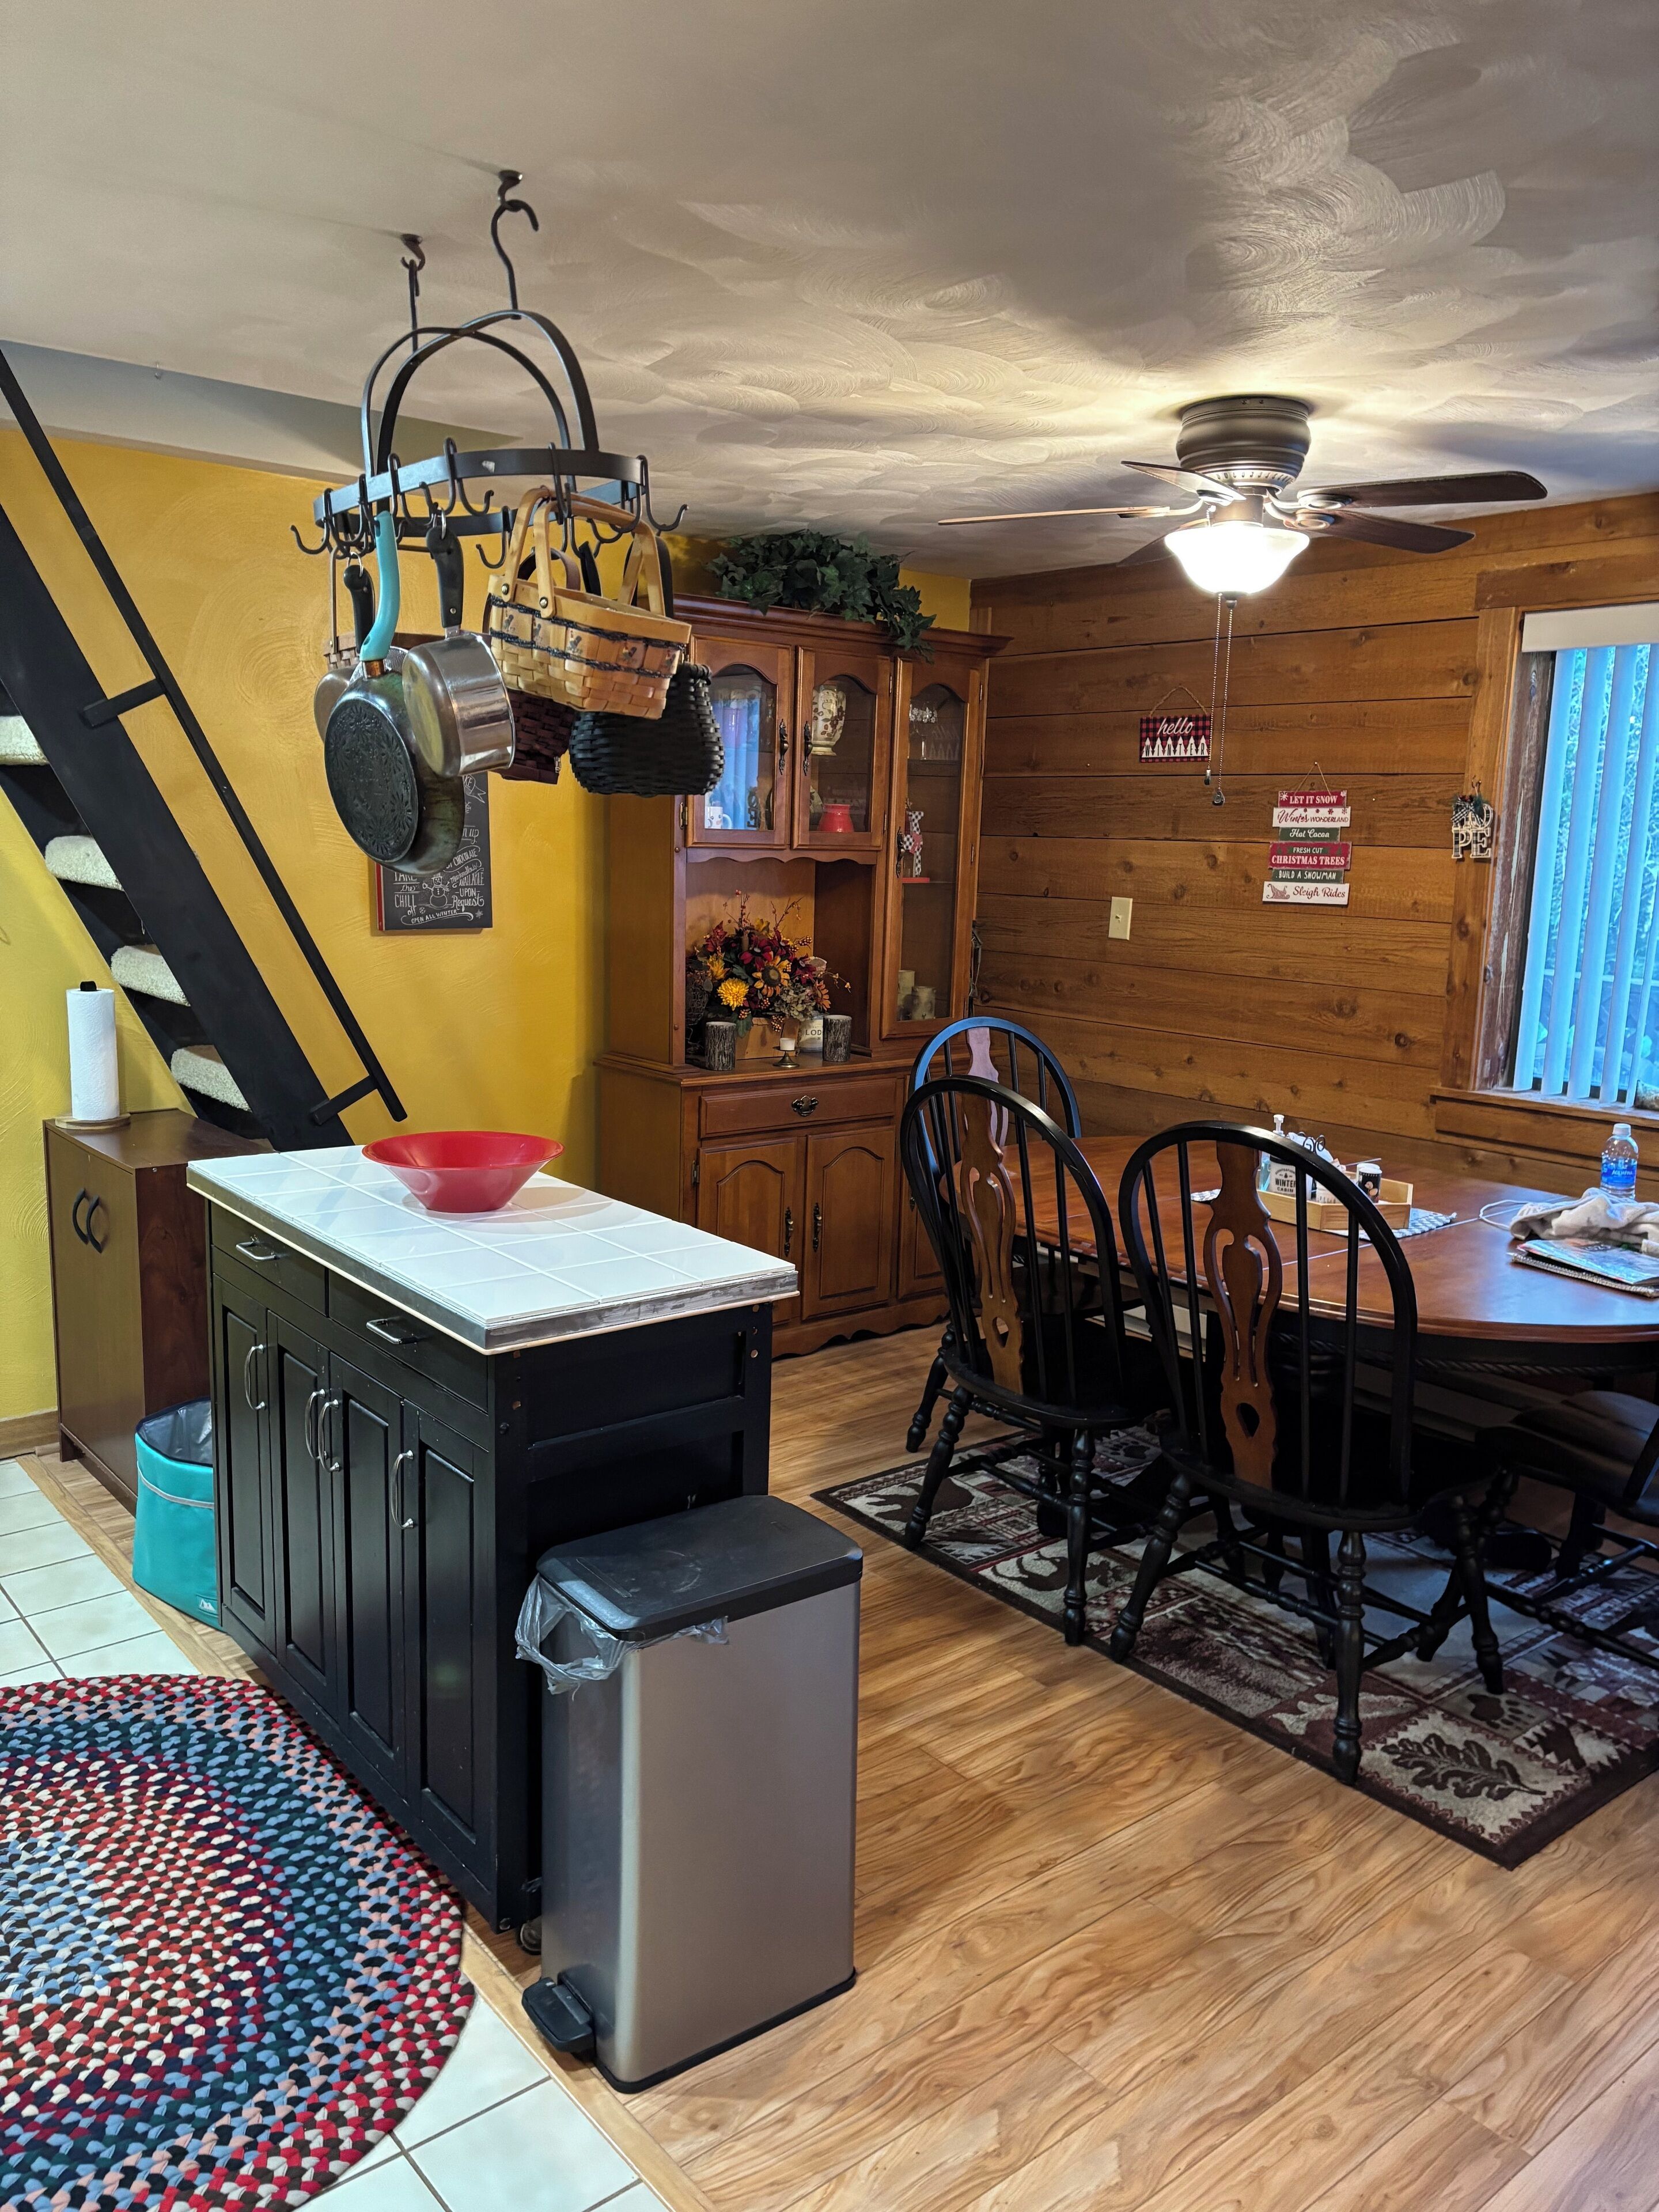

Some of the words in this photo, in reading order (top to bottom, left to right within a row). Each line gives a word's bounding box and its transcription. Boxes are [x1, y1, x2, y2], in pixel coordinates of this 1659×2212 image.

[1157, 717, 1196, 735] hello
[1145, 743, 1205, 756] WINTER
[1289, 796, 1305, 804] LET
[1306, 796, 1315, 804] IT
[1315, 796, 1338, 804] SNOW
[1278, 808, 1309, 824] Winter
[1289, 828, 1306, 838] Hot
[1308, 828, 1330, 838] Cocoa
[1271, 855, 1318, 865] CHRISTMAS
[1319, 856, 1345, 865] TREES
[1278, 870, 1295, 879] BUILD
[1297, 870, 1302, 879] A
[1304, 870, 1336, 880] SNOWMAN
[1293, 885, 1320, 899] Sleigh
[1322, 887, 1346, 898] Rides
[395, 894, 417, 908] CHILL
[451, 893, 484, 912] Request
[411, 916, 425, 925] OPEN
[435, 909, 457, 918] WINTER
